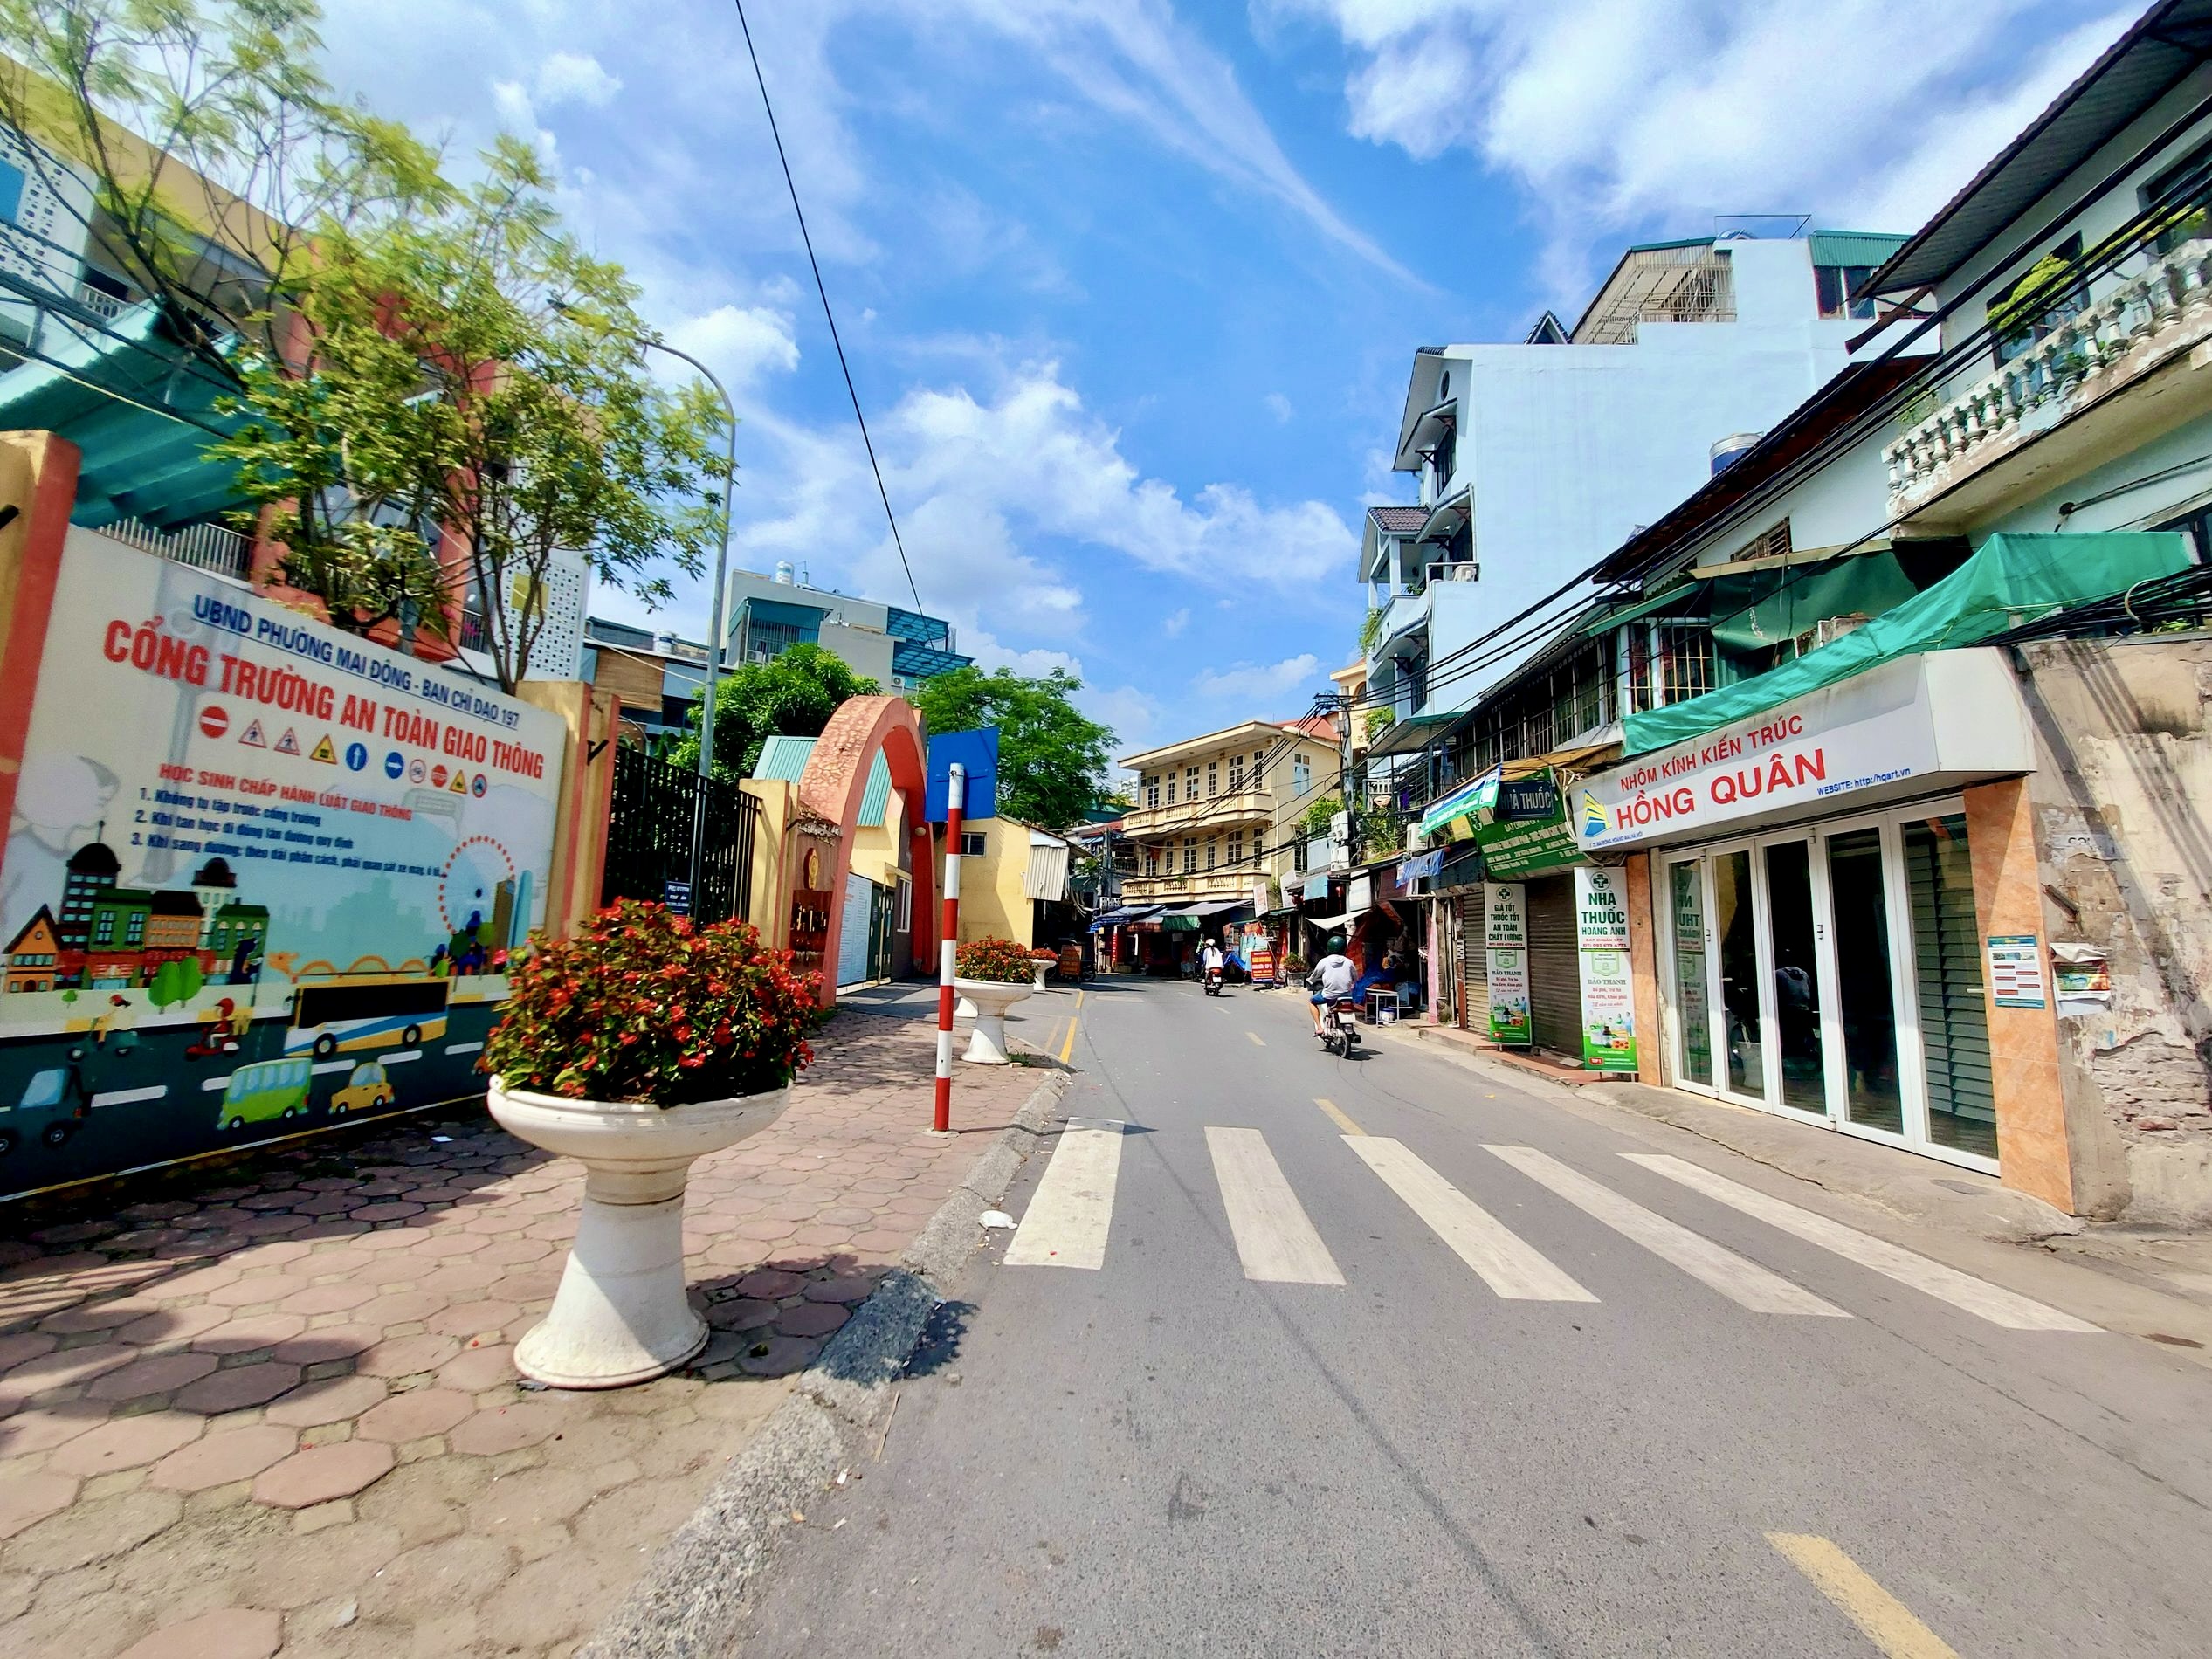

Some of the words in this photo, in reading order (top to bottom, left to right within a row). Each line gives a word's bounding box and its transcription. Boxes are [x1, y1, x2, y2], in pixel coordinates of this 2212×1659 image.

[195, 594, 252, 633] UBND
[257, 618, 333, 662] PHƯỜNG
[336, 647, 367, 675] MAI
[370, 658, 411, 691] ĐỘNG
[423, 679, 449, 703] BAN
[474, 698, 499, 722] ĐẠO
[502, 709, 520, 726] 197
[103, 615, 210, 685] CỔNG
[218, 653, 335, 720] TRƯỜNG
[340, 695, 376, 733] AN
[383, 706, 439, 750] TOÀN
[443, 726, 486, 763] GIAO
[492, 740, 544, 779] THÔNG
[1620, 768, 1657, 792] NHÔM
[1662, 754, 1697, 779] KÍNH
[1702, 733, 1742, 766] KIẾN
[1747, 715, 1803, 749] TRÚC
[140, 788, 151, 801] 1.
[159, 763, 194, 783] HỌC
[197, 770, 236, 790] SINH
[239, 777, 278, 796] CHẤP
[280, 785, 316, 804] HÀNH
[319, 793, 348, 810] LUẬT
[351, 799, 376, 814] GIAO
[379, 804, 412, 821] THÔNG
[1616, 789, 1695, 830] HỒNG
[1710, 748, 1827, 805] QUÂN
[1817, 781, 1853, 795] WEBSITE:
[1520, 786, 1551, 809] THUỐC
[134, 809, 147, 823] 2.
[131, 832, 142, 845] 3.
[1588, 890, 1616, 905] NHÀ
[1490, 912, 1508, 921] THUỐC
[1581, 906, 1625, 924] THUỐC
[1581, 925, 1608, 935] HOÀNG
[1610, 926, 1626, 935] ANH
